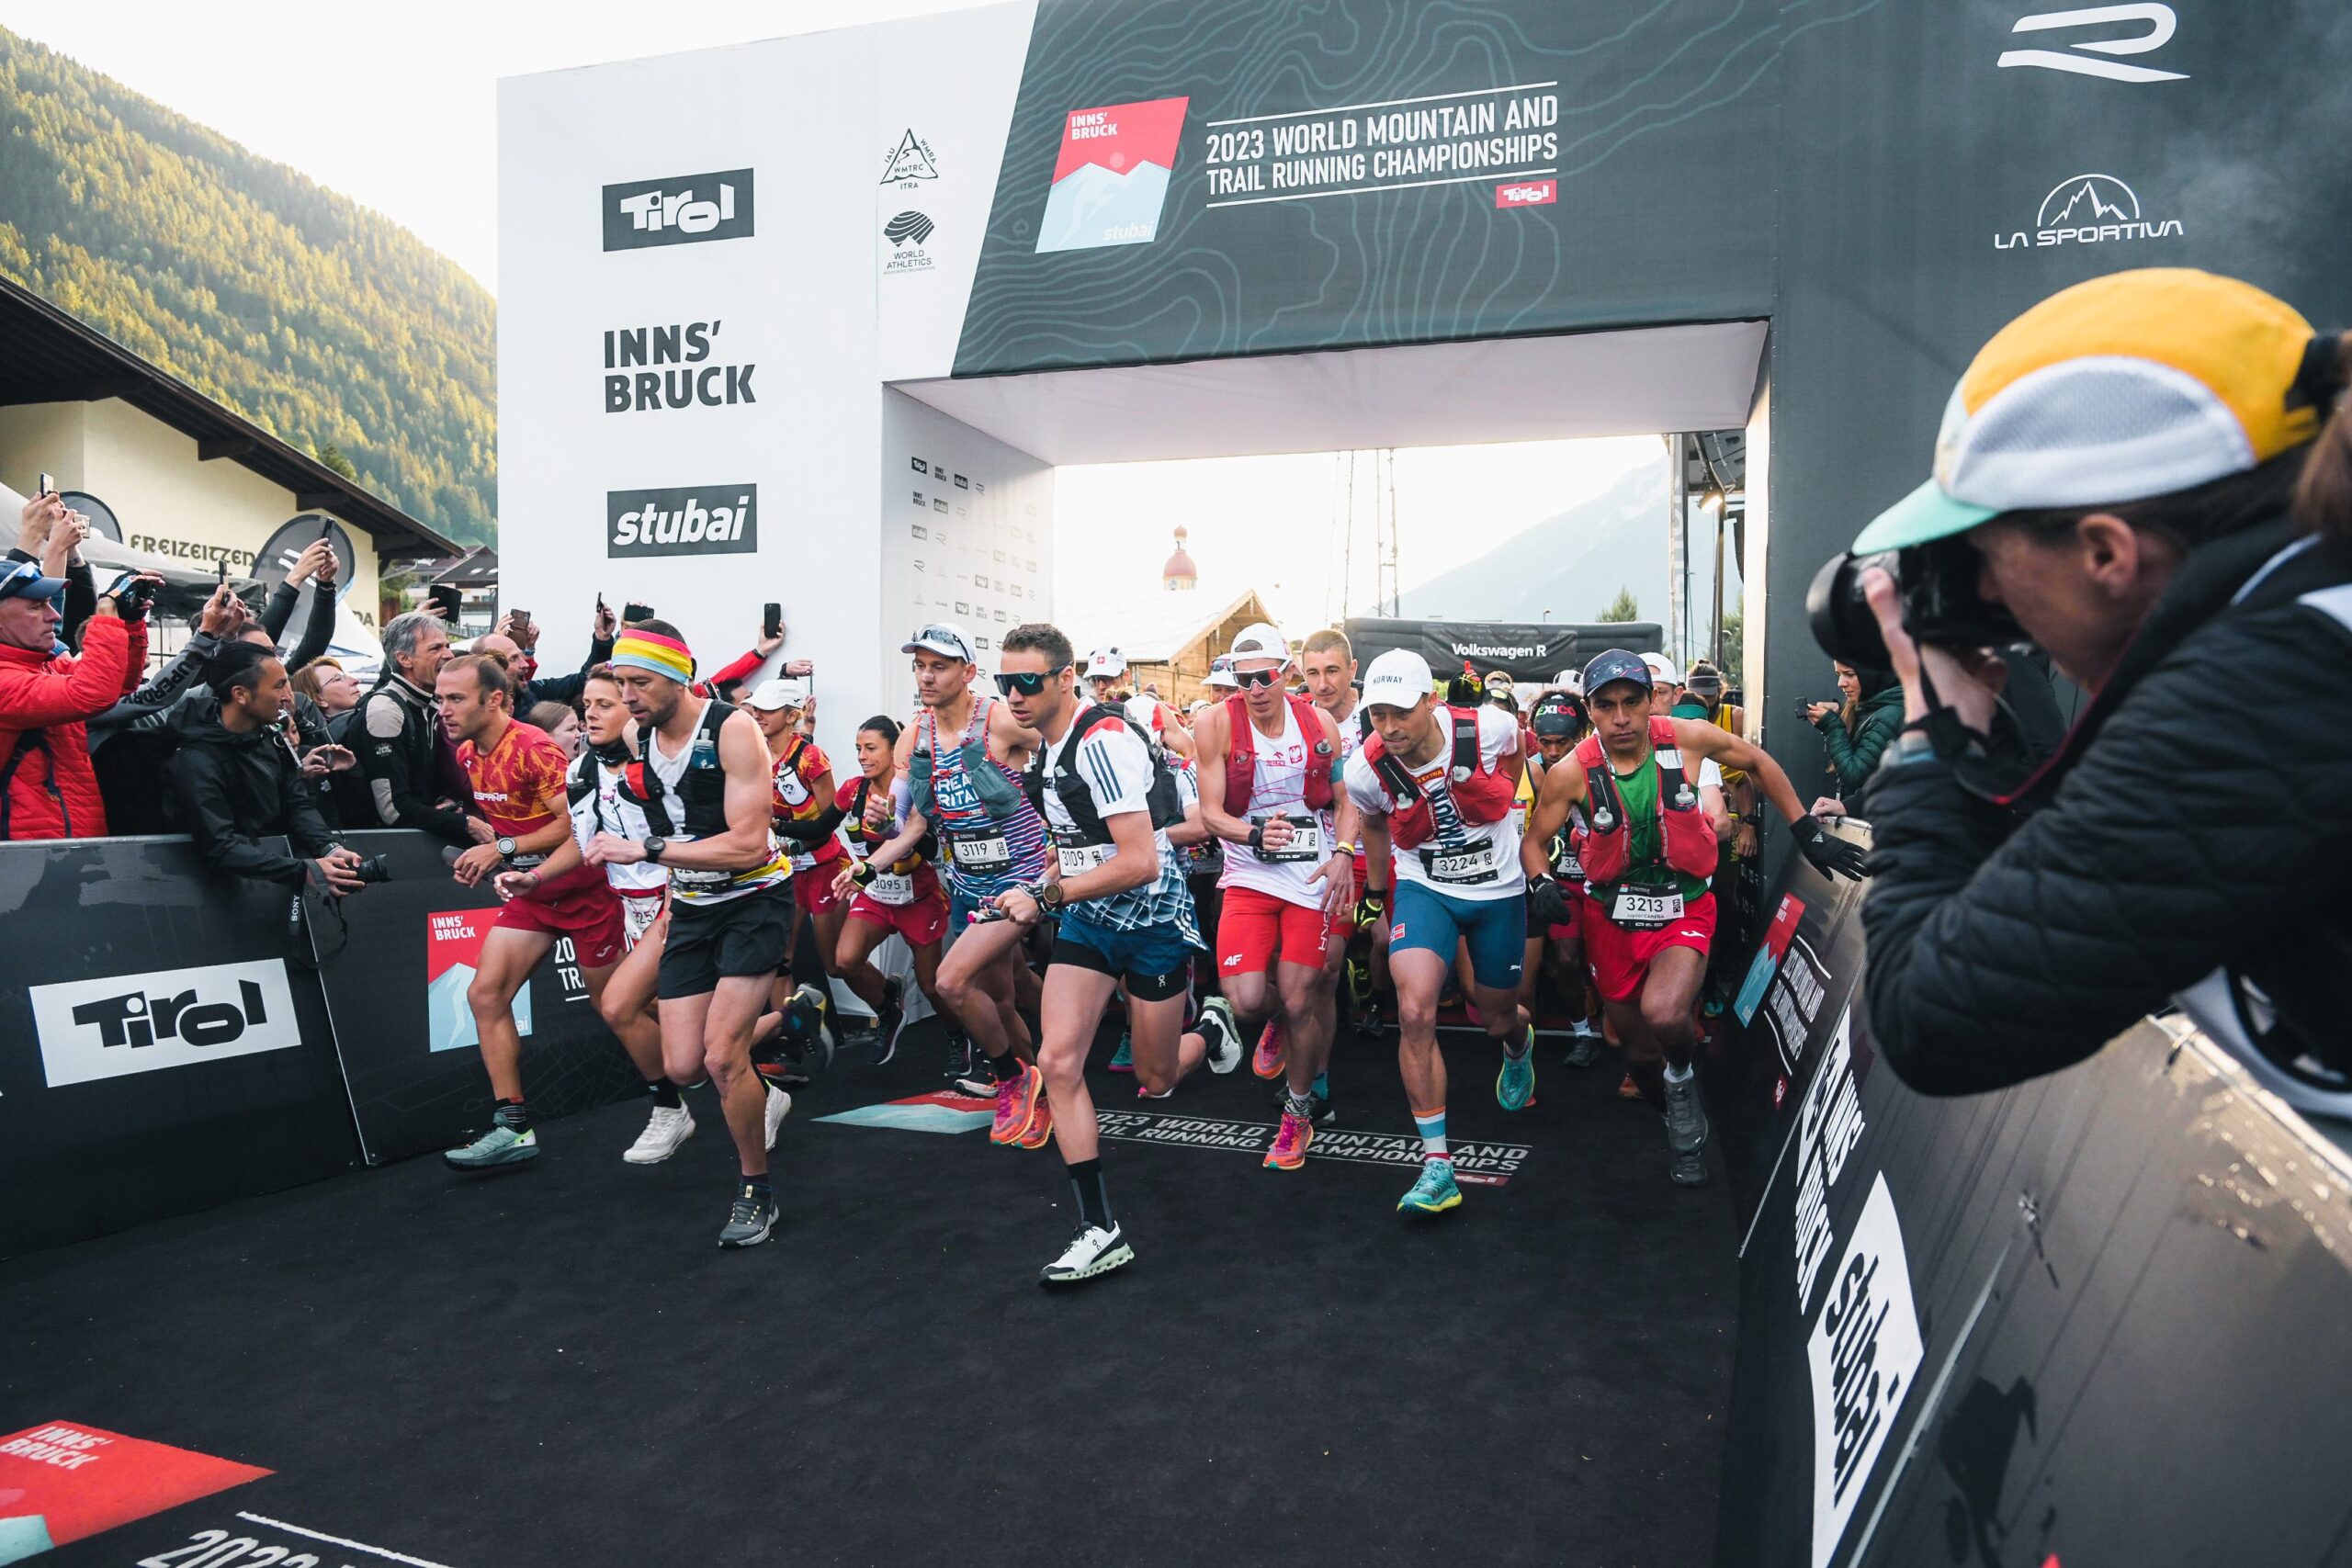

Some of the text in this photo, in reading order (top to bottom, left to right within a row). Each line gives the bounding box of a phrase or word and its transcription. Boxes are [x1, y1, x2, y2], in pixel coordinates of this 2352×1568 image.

[1071, 112, 1108, 128] INNS'
[1071, 123, 1118, 140] BRUCK
[1206, 95, 1558, 164] 2023 WORLD MOUNTAIN AND
[893, 164, 924, 174] WMTRC
[1206, 132, 1557, 195] TRAIL RUNNING CHAMPIONSHIPS
[900, 182, 919, 190] ITRA
[1503, 185, 1550, 202] Tirol
[620, 184, 735, 233] Tirol
[1102, 221, 1153, 242] stubai
[1994, 220, 2184, 249] LA SPORTIVA
[887, 257, 933, 269] ATHLETICS
[893, 250, 925, 259] WORLD
[604, 320, 721, 368] INNS'
[605, 364, 757, 413] BRUCK
[612, 495, 750, 546] stubai
[130, 534, 256, 567] FREIZEITZEN
[1452, 643, 1547, 660] Volkswagen R
[1373, 675, 1403, 685] NORWAY
[1535, 705, 1577, 716] EXICO
[961, 842, 988, 857] 3119
[1061, 850, 1084, 866] 3109
[1439, 854, 1478, 872] 3224
[290, 894, 300, 921] SONY
[1626, 897, 1664, 913] 3213
[433, 916, 464, 930] INNS'
[435, 926, 476, 941] BRUCK
[72, 979, 267, 1049] Tirol
[1095, 1113, 1151, 1126] 023
[1155, 1118, 1268, 1136] WORLD
[1453, 1145, 1530, 1160] AND
[1136, 1128, 1263, 1147] RUNNING
[1825, 1252, 1900, 1509] stubai
[1, 1438, 99, 1470] BRUCK
